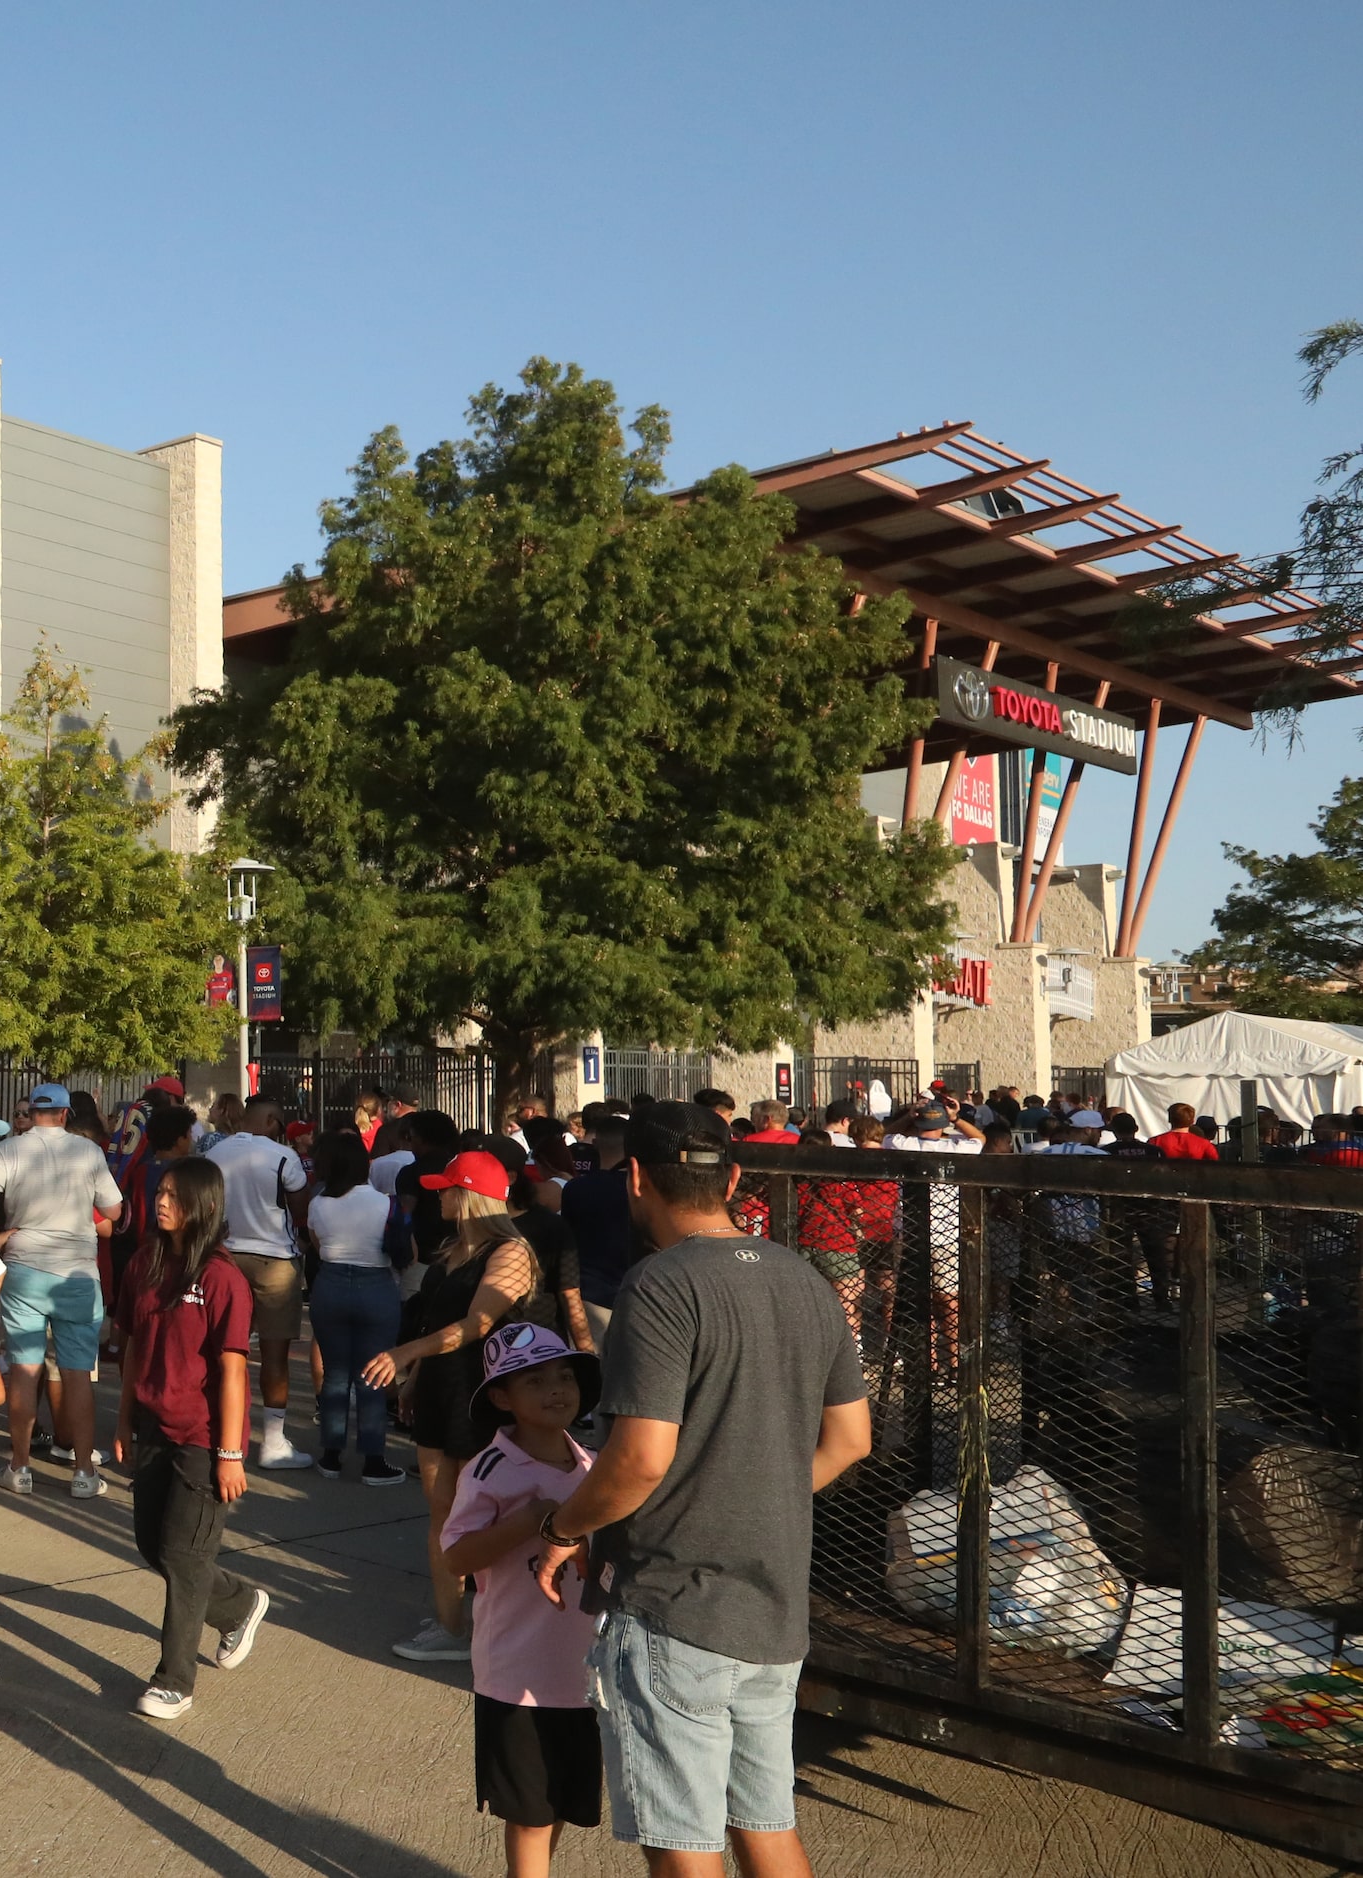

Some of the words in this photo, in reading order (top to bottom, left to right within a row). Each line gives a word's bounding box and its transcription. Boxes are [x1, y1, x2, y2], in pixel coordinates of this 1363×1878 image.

[989, 685, 1063, 734] TOYOTA
[1063, 709, 1136, 758] STADIUM
[954, 773, 968, 801] WE
[971, 777, 991, 809] ARE
[952, 799, 962, 819] FC
[963, 804, 993, 829] DALLAS
[588, 1058, 597, 1081] 1
